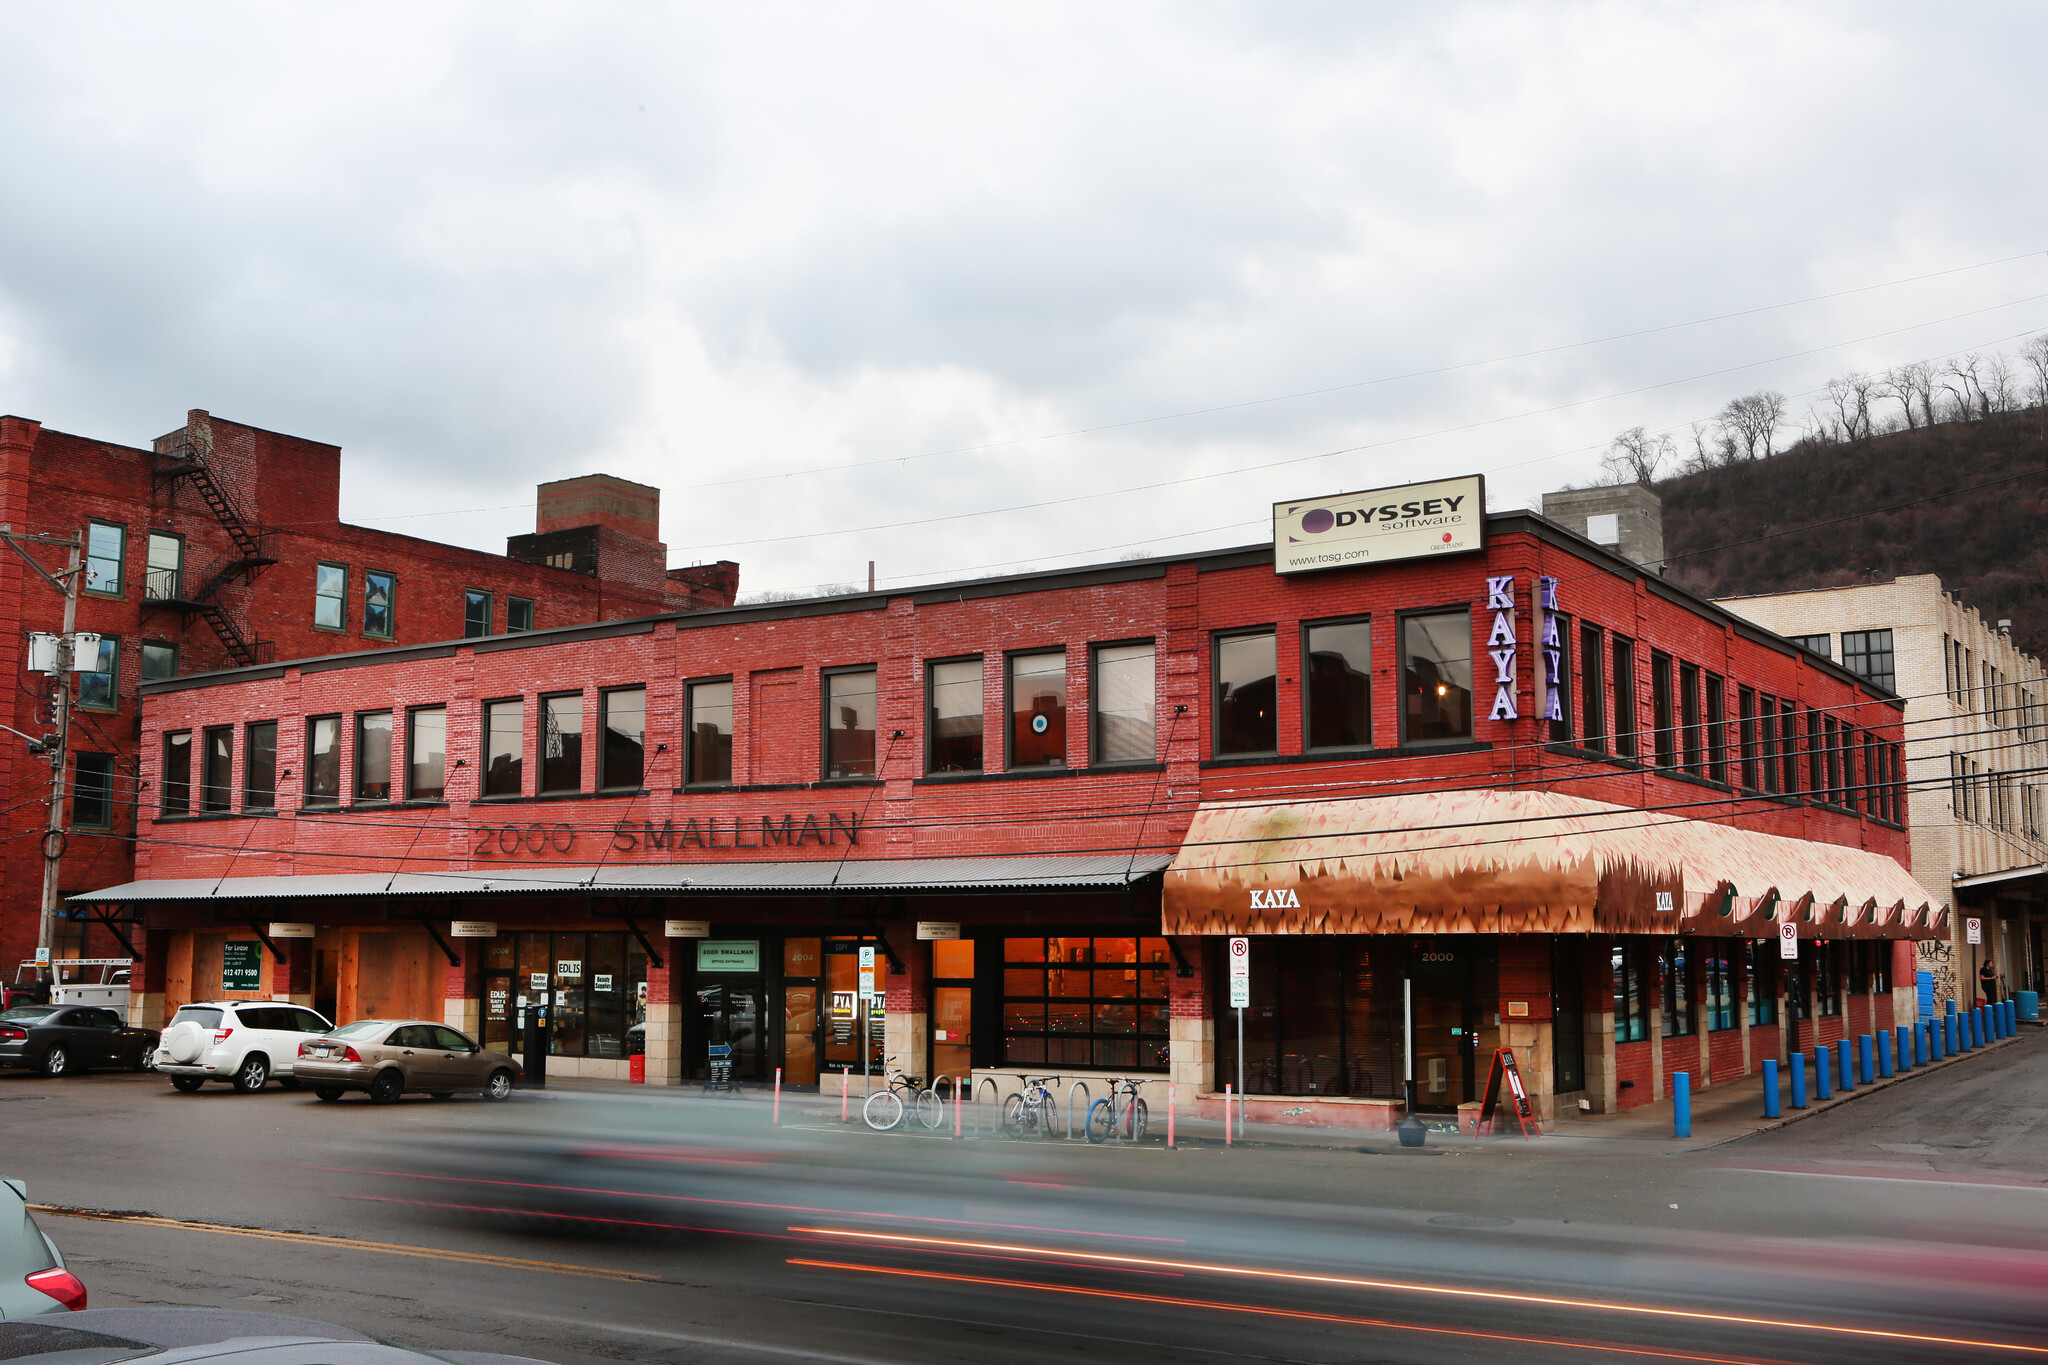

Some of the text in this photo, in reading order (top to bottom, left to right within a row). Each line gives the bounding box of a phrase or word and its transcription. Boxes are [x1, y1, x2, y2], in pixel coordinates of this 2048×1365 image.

[1381, 514, 1462, 531] software
[1289, 549, 1369, 567] www.tosg.com
[1486, 575, 1518, 721] KAYA
[1543, 576, 1563, 722] KAYA
[474, 811, 861, 855] 2000 SMALLMAN
[1249, 888, 1301, 909] KAYA
[1656, 891, 1673, 911] KAYA
[1422, 952, 1454, 962] 2000
[245, 969, 258, 977] 9500
[558, 963, 581, 974] EDLIS
[490, 990, 506, 998] EDLIS
[834, 995, 851, 1008] PYA
